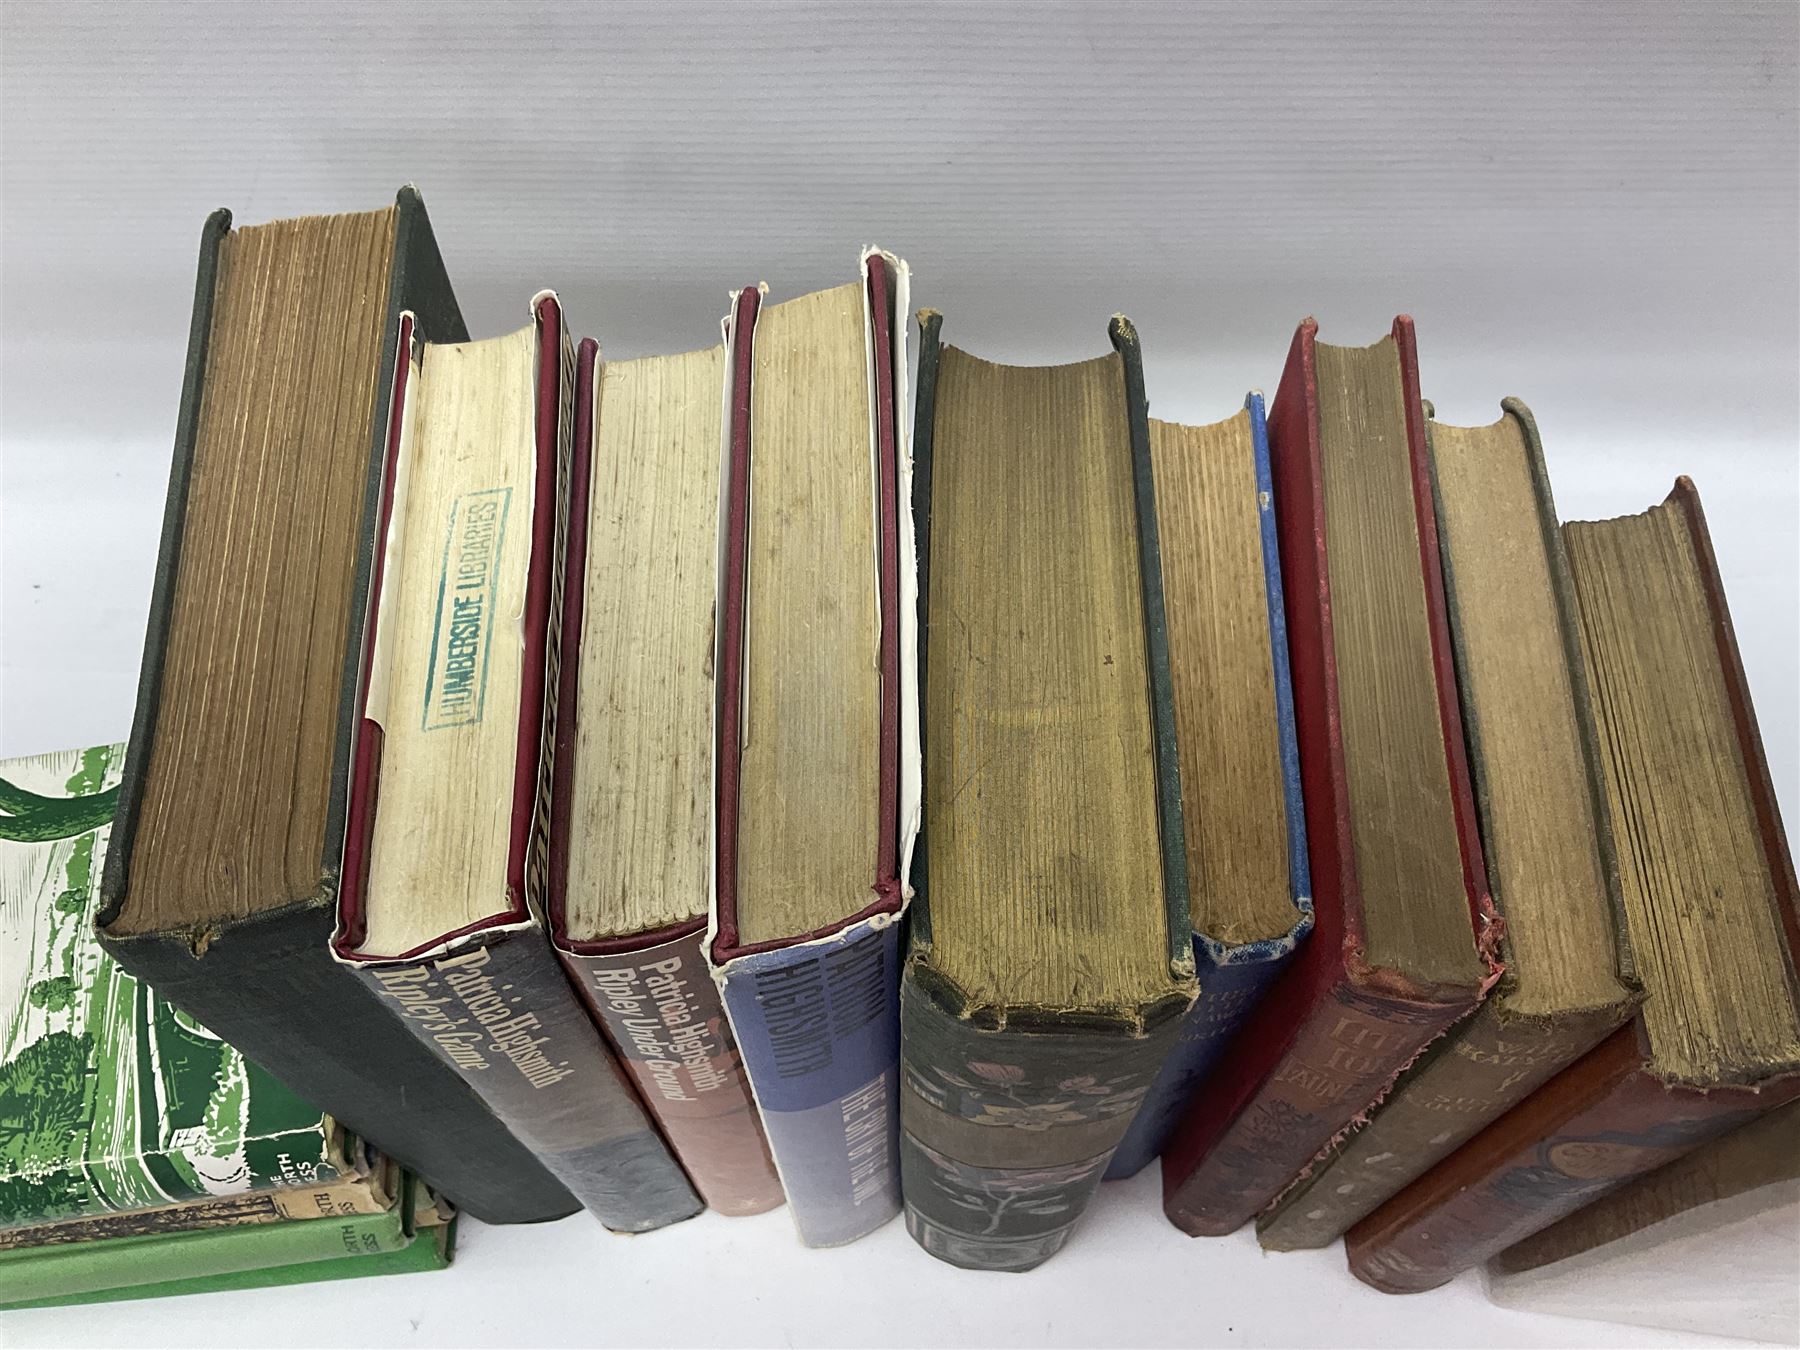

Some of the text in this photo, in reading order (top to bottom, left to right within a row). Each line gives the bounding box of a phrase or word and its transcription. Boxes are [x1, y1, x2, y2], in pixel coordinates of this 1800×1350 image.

[440, 500, 498, 719] HUMBERSIDE LIBRARIES
[371, 964, 490, 1071] Ripley's Game
[434, 946, 575, 1089] Patricia Highsmith
[592, 967, 698, 1101] Ripley Under Ground
[639, 956, 728, 1092] Patricia Highsmith
[841, 1072, 886, 1122] THE
